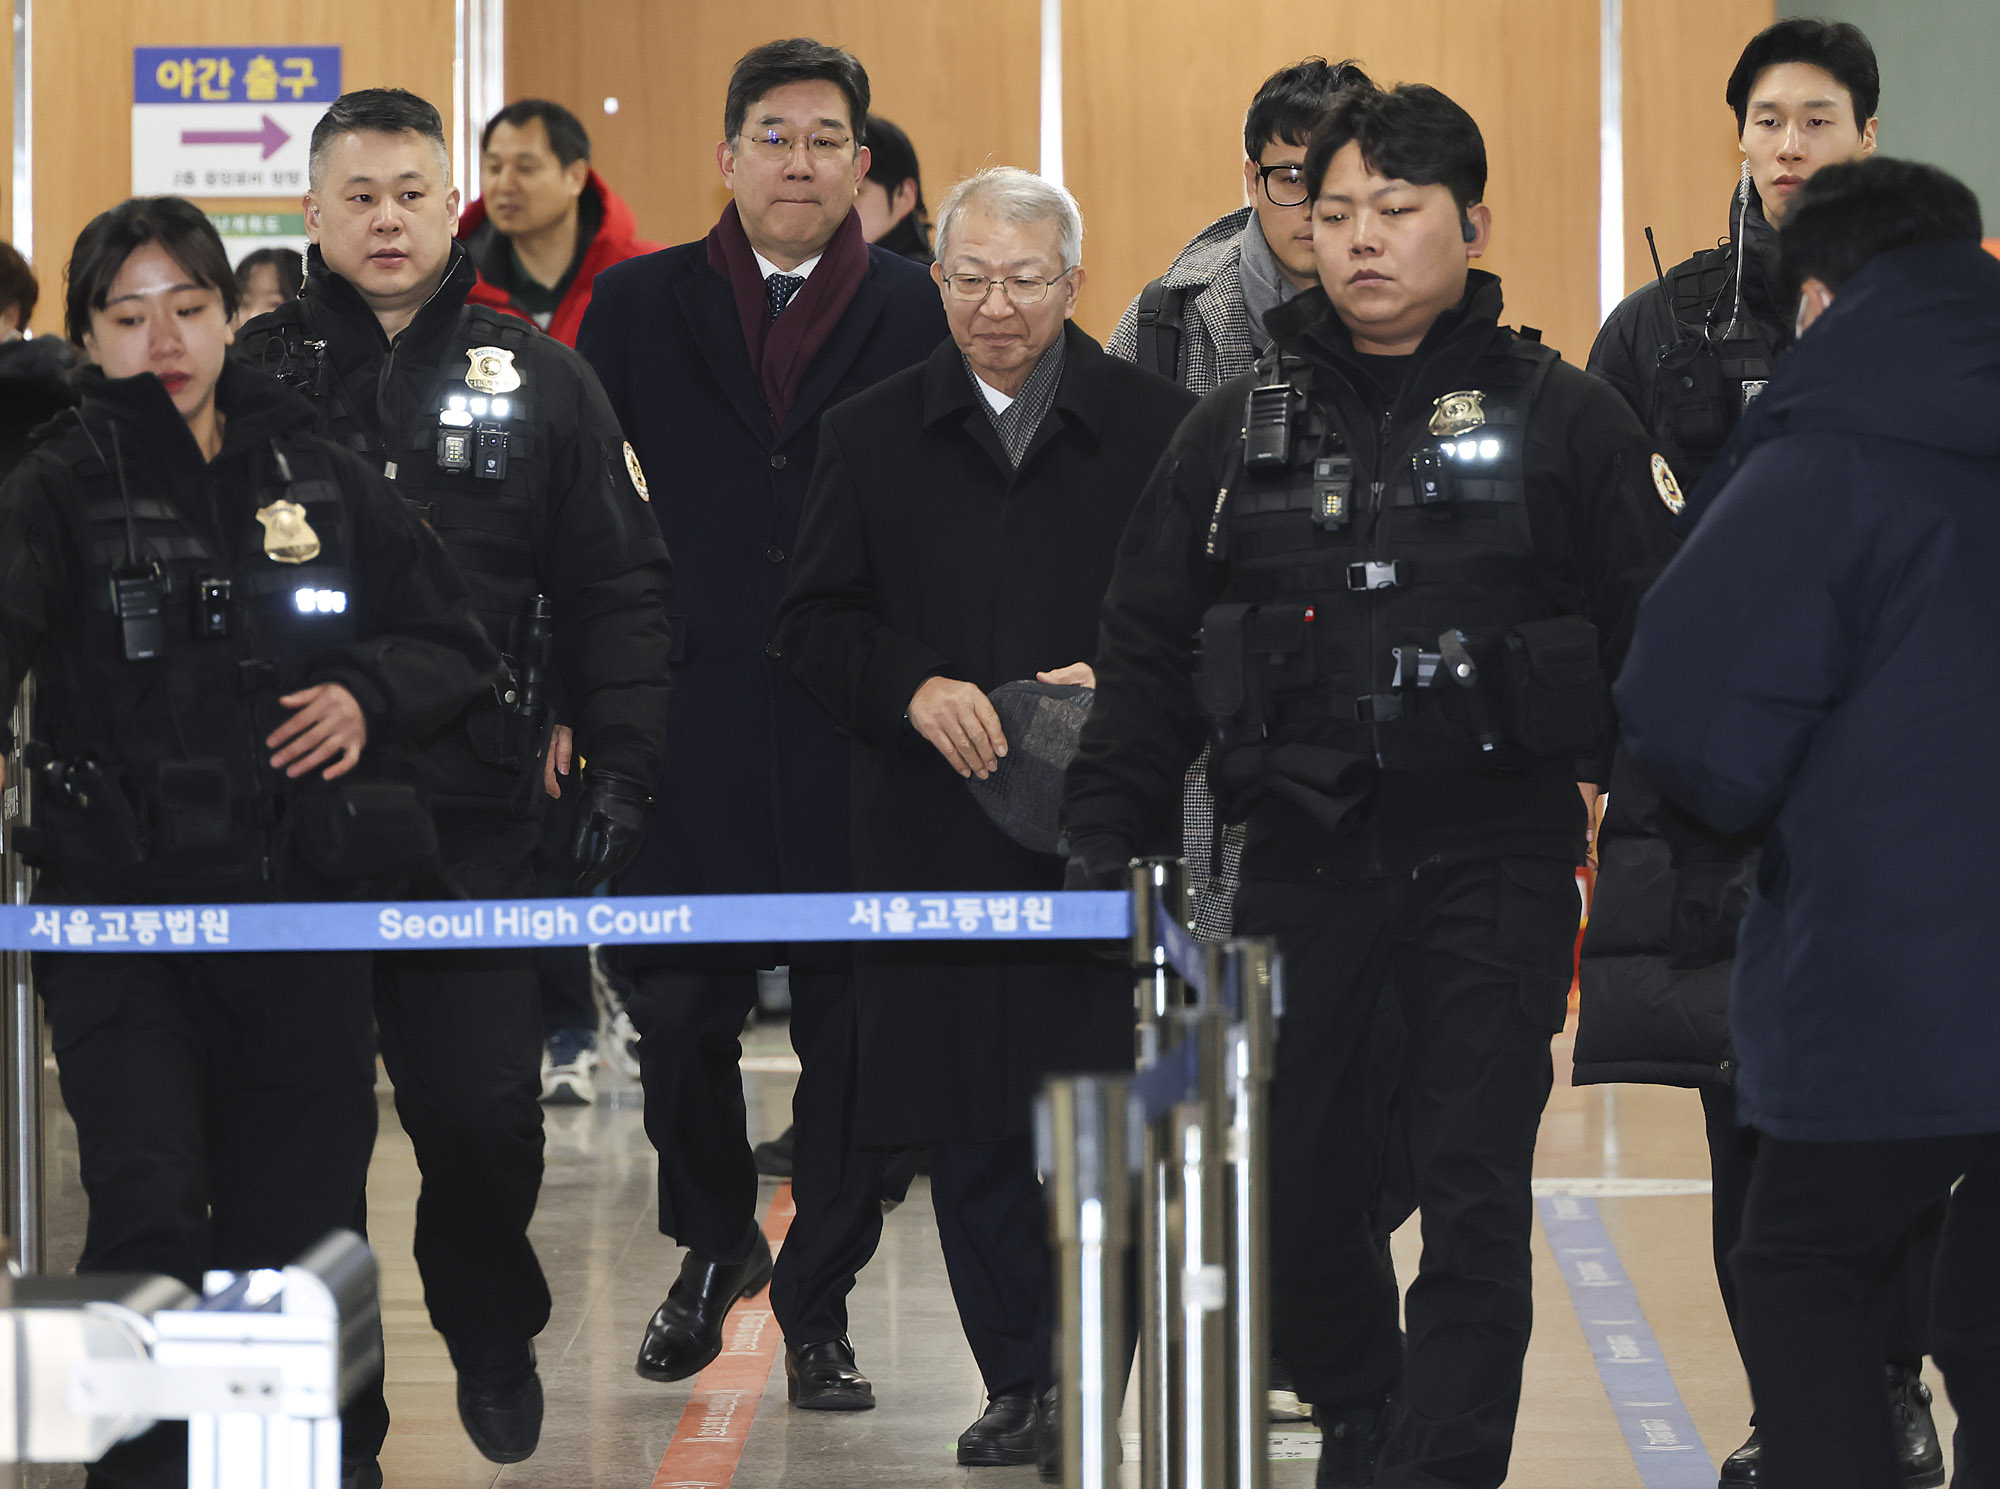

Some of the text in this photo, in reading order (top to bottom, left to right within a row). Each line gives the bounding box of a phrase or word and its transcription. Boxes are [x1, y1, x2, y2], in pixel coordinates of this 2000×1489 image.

[156, 55, 318, 100] 야간 출구
[30, 909, 230, 946] 서울고등법원
[379, 903, 692, 942] Seoul High Court
[849, 896, 1054, 934] 서울고등법원
